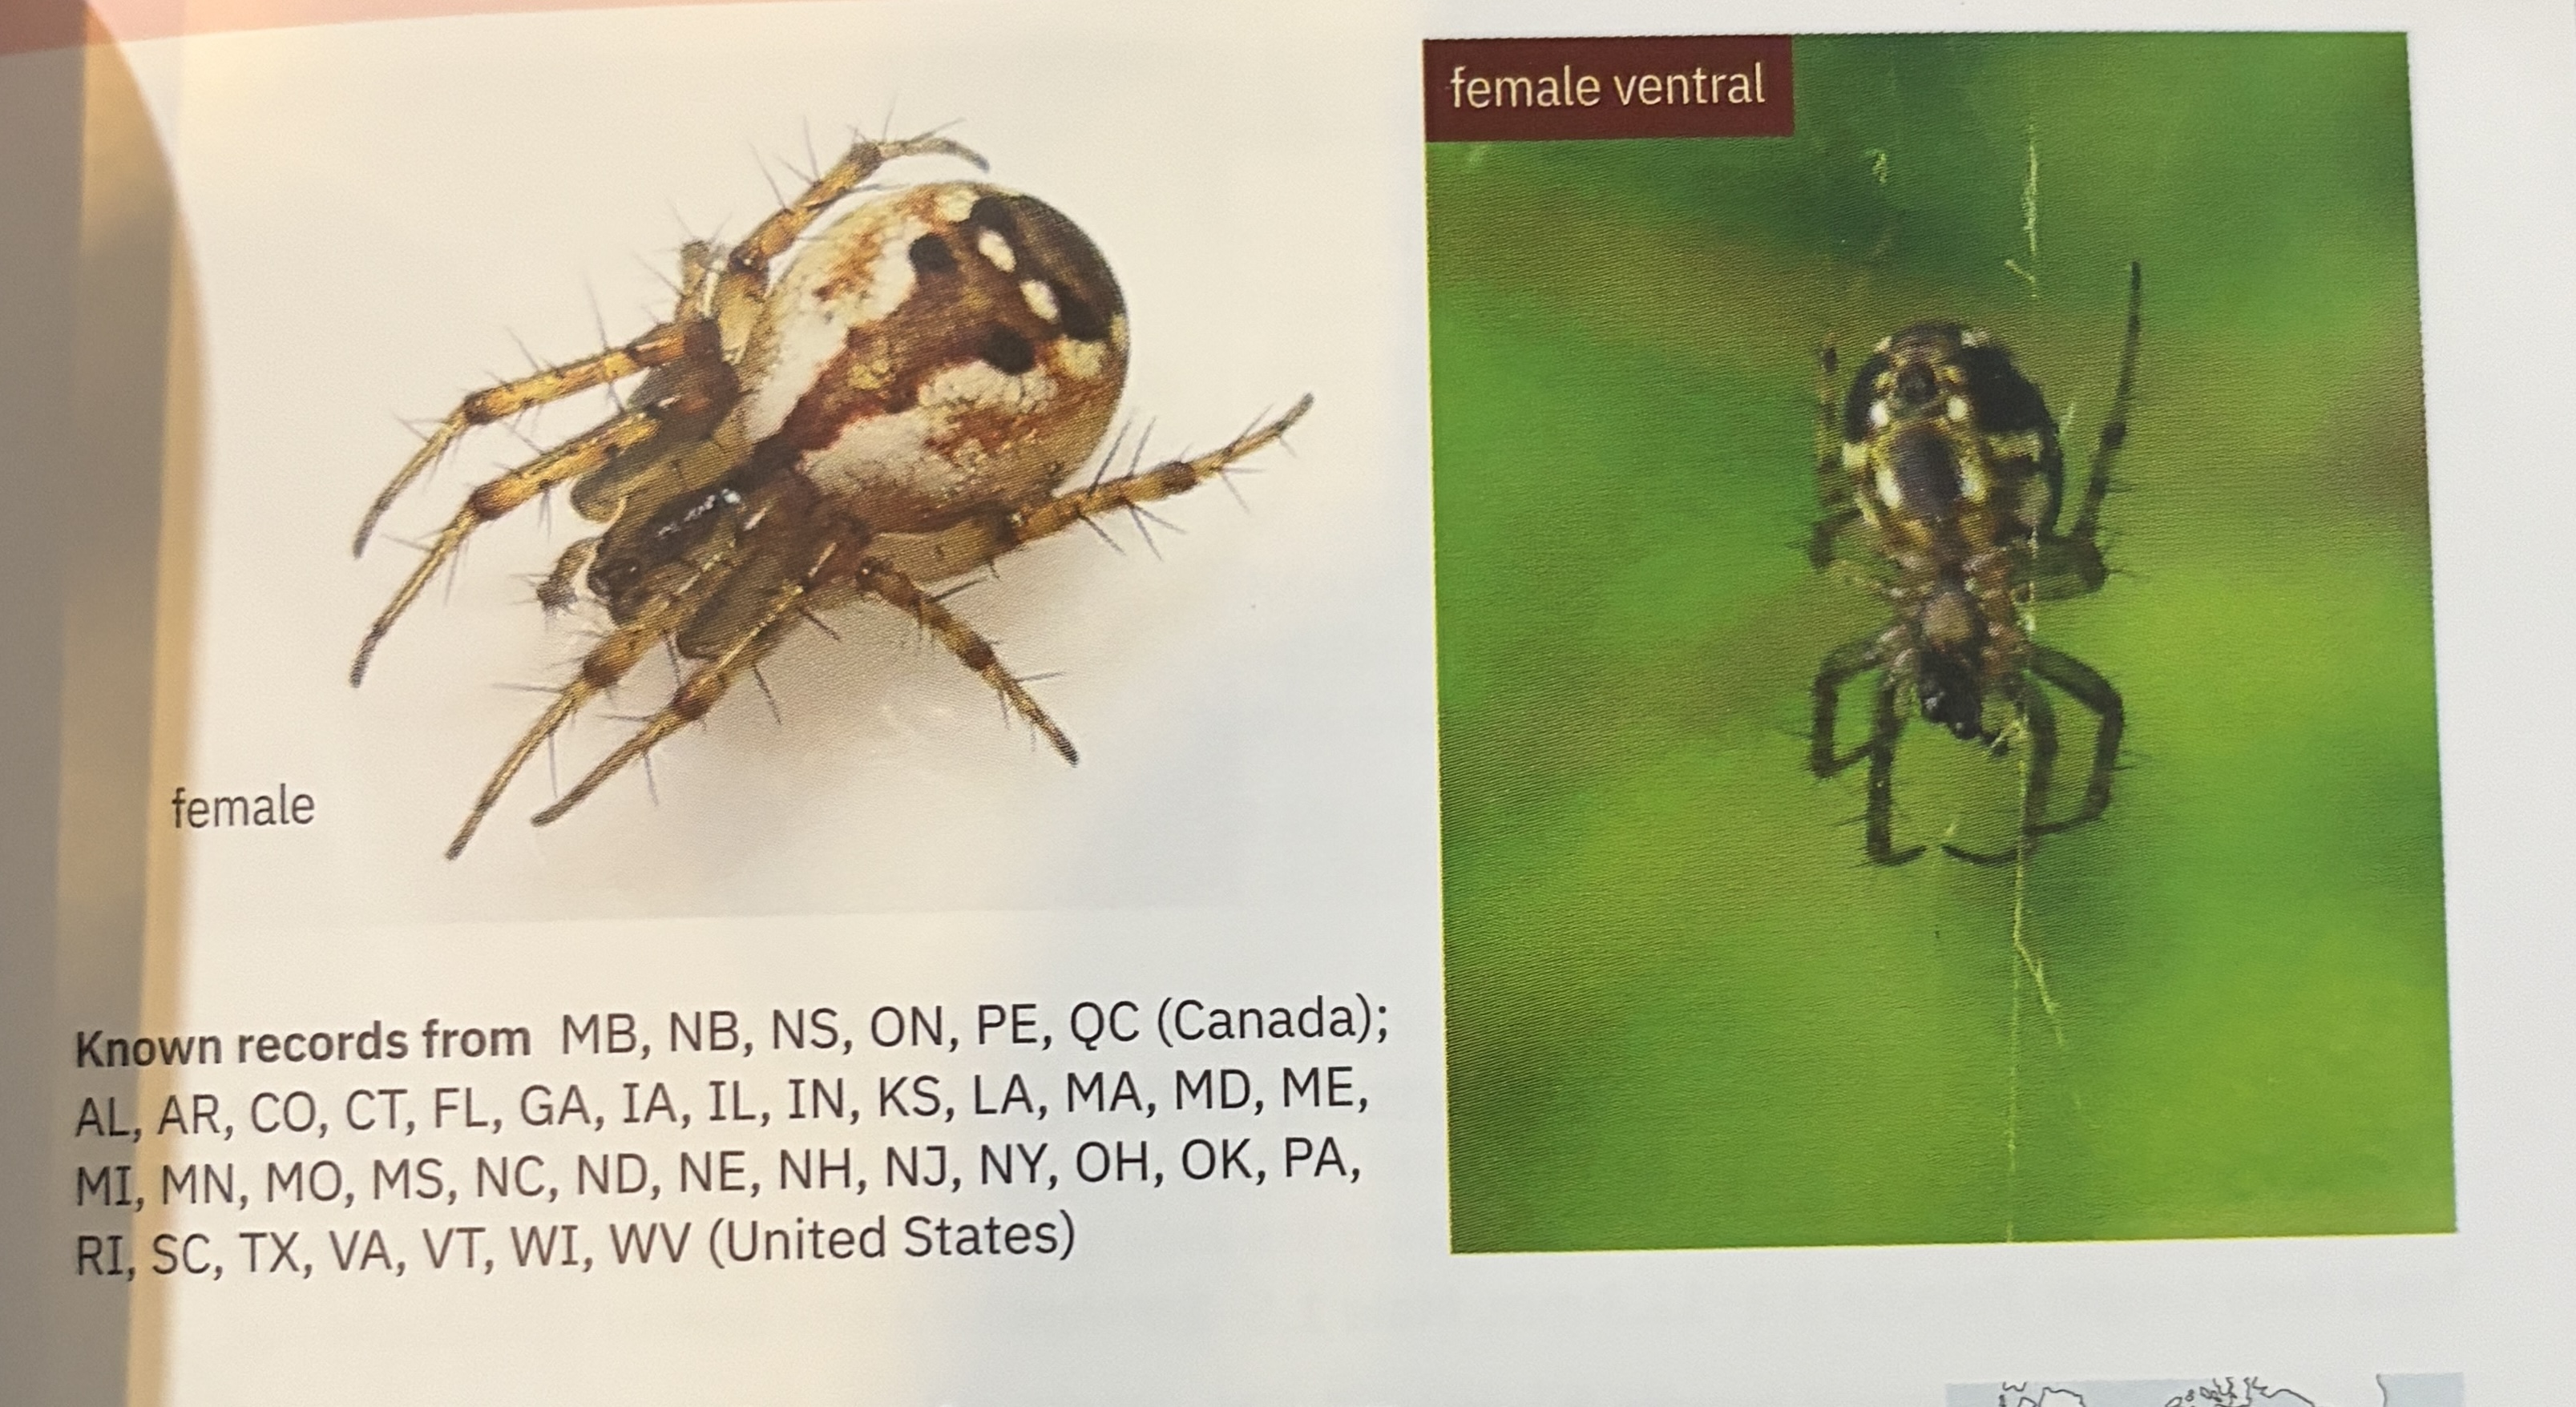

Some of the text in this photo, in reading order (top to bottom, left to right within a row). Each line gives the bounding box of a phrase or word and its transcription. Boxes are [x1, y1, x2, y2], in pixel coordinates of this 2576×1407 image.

[1448, 61, 1766, 109] female ventral
[171, 782, 315, 829] female
[75, 992, 1387, 1069] Known records from MB, NB, NS, ON, PE, QC (Canada);
[74, 1066, 1368, 1144] AL, AR, CO, CT, FL, GA, IA, IL, IN, KS, LA, MA, MD, ME,
[76, 1135, 1360, 1213] MI, MN, MO, MS, NC, ND, NE, NH, NJ, NY, OH, OK, PA,
[76, 1208, 1076, 1283] RI, SC, TX, VA, VT, WI, WV (United States)
